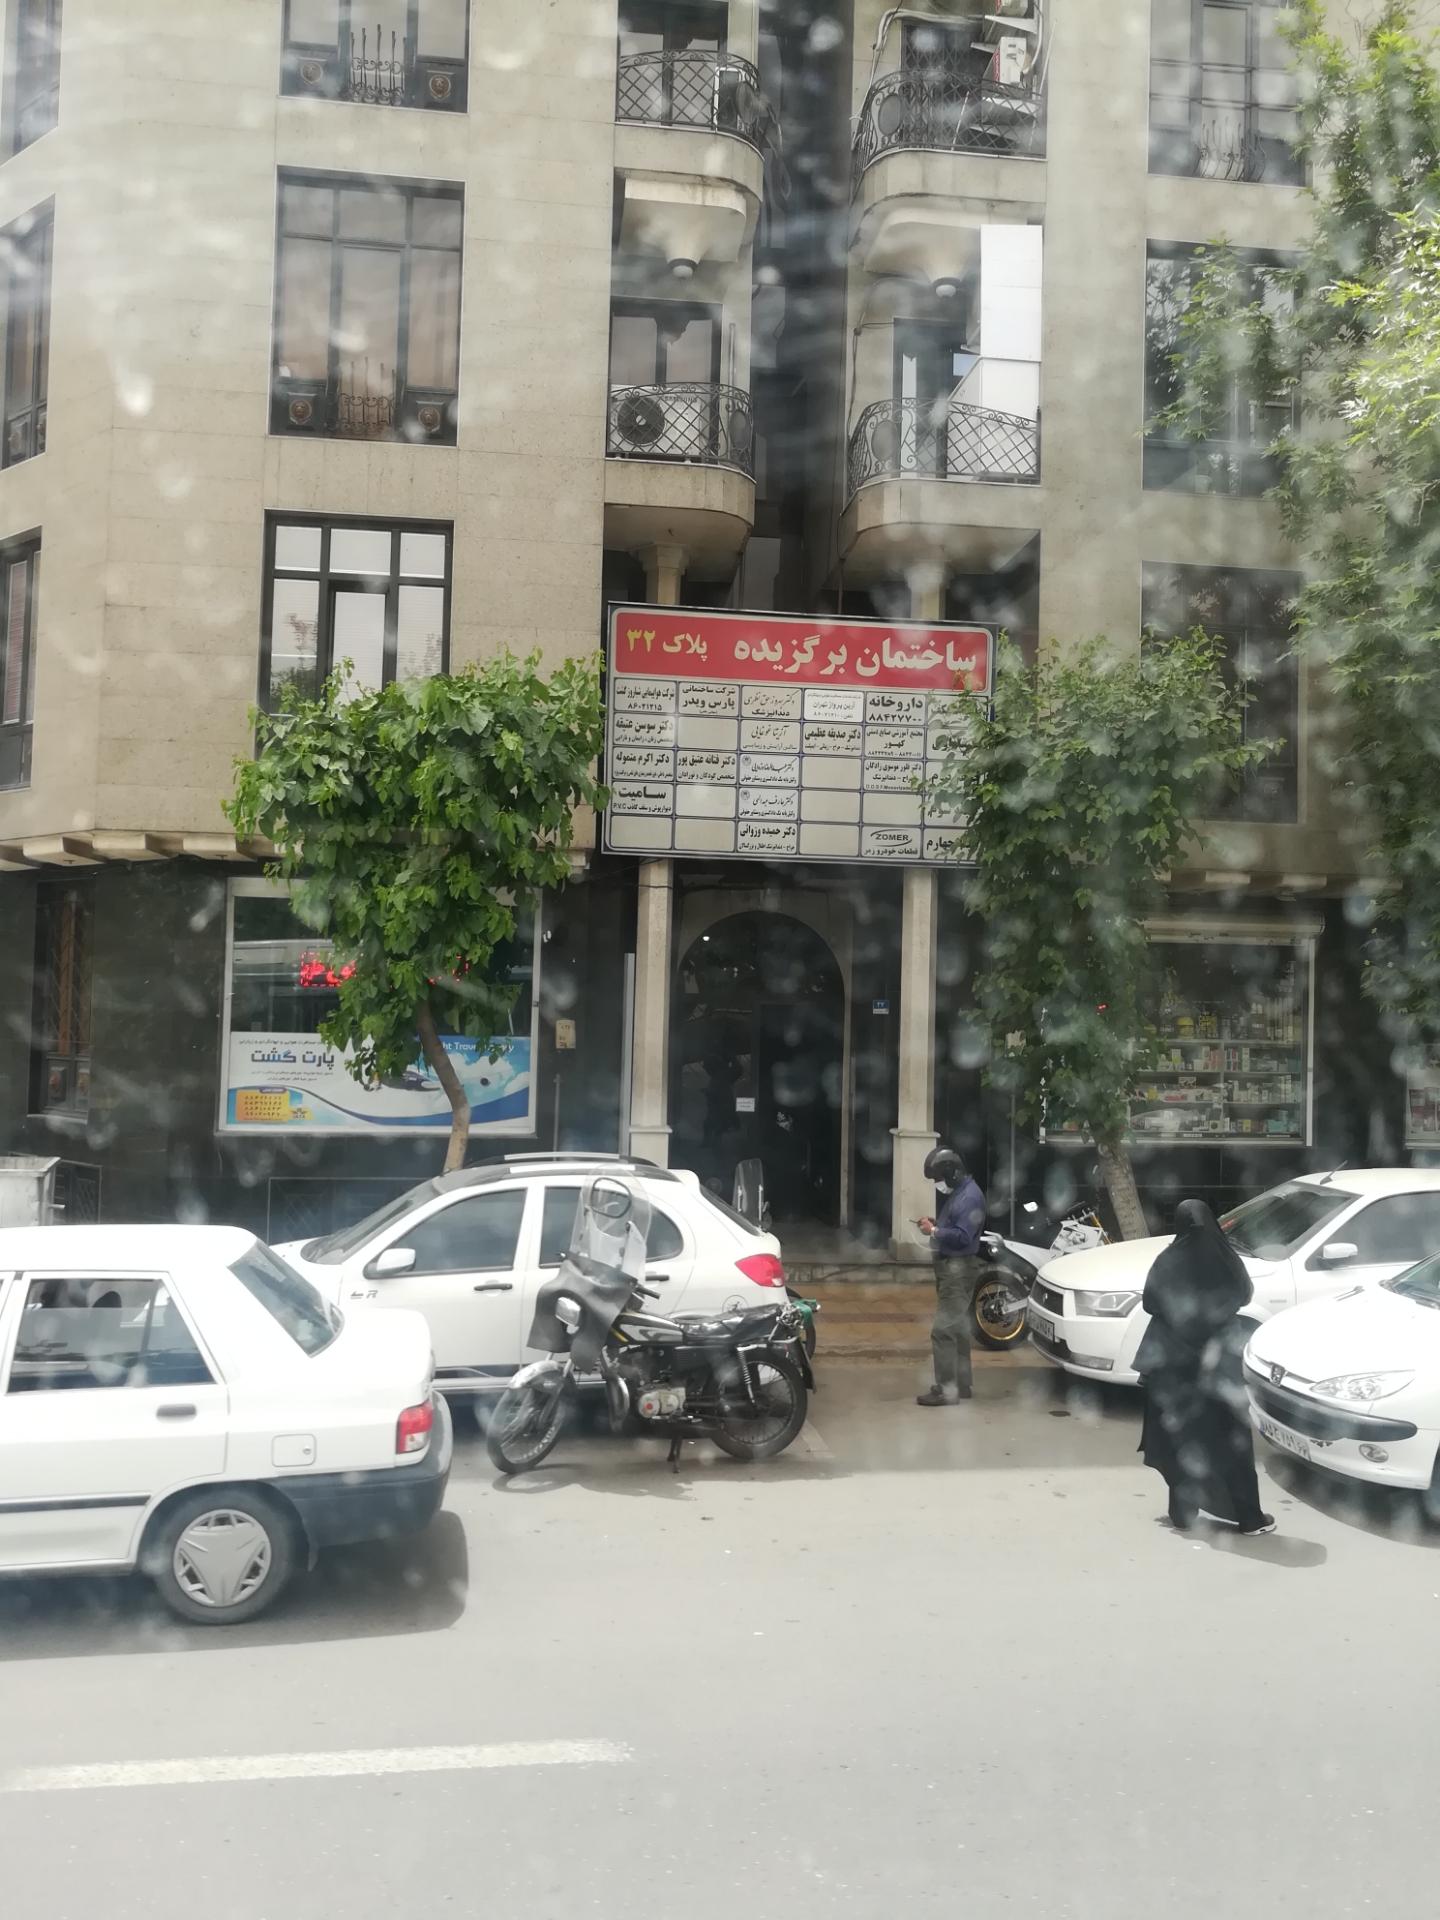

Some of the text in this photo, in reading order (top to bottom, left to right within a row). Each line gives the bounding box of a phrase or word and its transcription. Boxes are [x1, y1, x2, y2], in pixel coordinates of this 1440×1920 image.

[626, 628, 977, 677] ساختمان برگزیده پلاک ۳۲
[869, 695, 924, 712] داروخانه
[654, 753, 670, 766] دکتر
[781, 826, 796, 838] دکتر
[874, 833, 909, 841] ZOMER
[251, 1047, 335, 1070] پارت گشت
